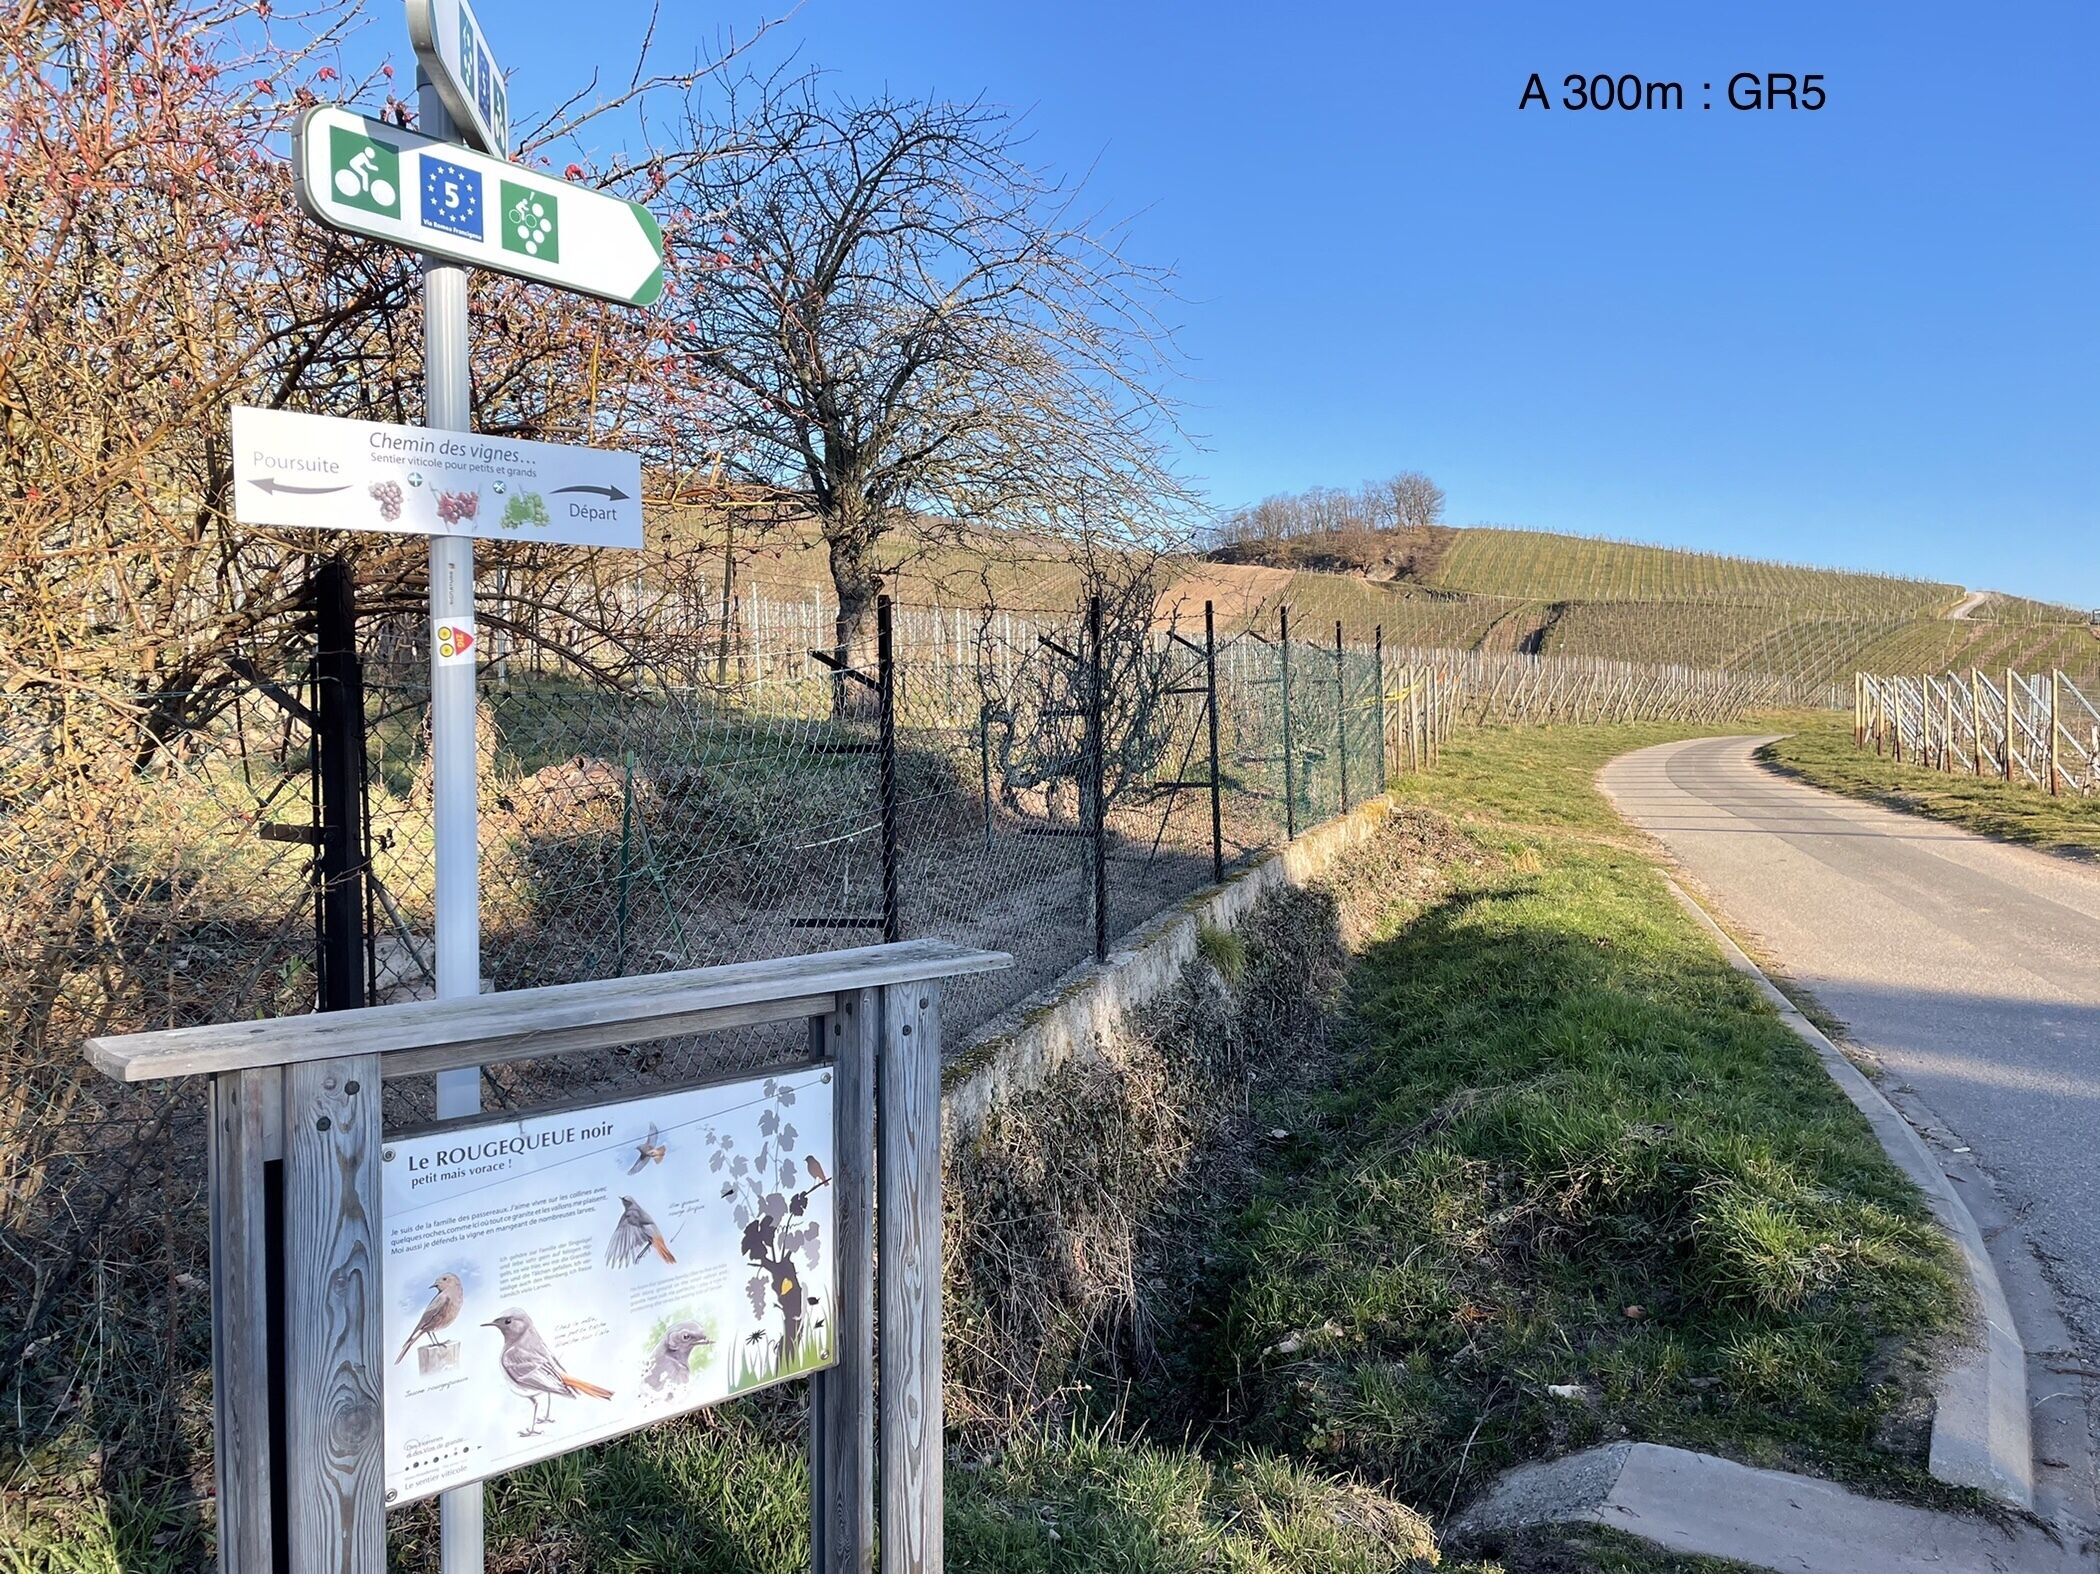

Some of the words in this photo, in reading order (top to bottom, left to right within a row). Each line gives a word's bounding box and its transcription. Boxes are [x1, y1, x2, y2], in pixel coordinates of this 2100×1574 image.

[445, 181, 460, 209] 5
[423, 218, 433, 227] Via
[369, 431, 435, 456] Chemin
[439, 438, 467, 458] des
[252, 450, 340, 475] Poursuite
[370, 452, 405, 466] Sentier
[407, 455, 443, 470] viticole
[444, 460, 467, 473] pour
[469, 460, 494, 477] petits
[496, 463, 506, 476] et
[507, 464, 537, 479] grands
[569, 502, 618, 523] Départ
[408, 1155, 429, 1172] Le
[436, 1127, 576, 1167] ROUGEQUEUE
[580, 1121, 614, 1141] noir
[411, 1170, 437, 1190] petit
[440, 1167, 466, 1181] mais
[469, 1161, 505, 1176] vorace
[390, 1247, 404, 1255] Moi
[405, 1243, 422, 1252] aussi
[423, 1241, 430, 1250] je
[466, 1229, 484, 1240] vigne
[495, 1220, 528, 1233] mangeant
[528, 1217, 537, 1226] de
[400, 1226, 413, 1234] suis
[414, 1223, 424, 1231] de
[433, 1217, 456, 1227] famille
[457, 1214, 470, 1222] des
[390, 1233, 422, 1246] quelques
[404, 1482, 414, 1491] Le
[415, 1473, 439, 1487] sentier
[440, 1464, 468, 1479] viticole
